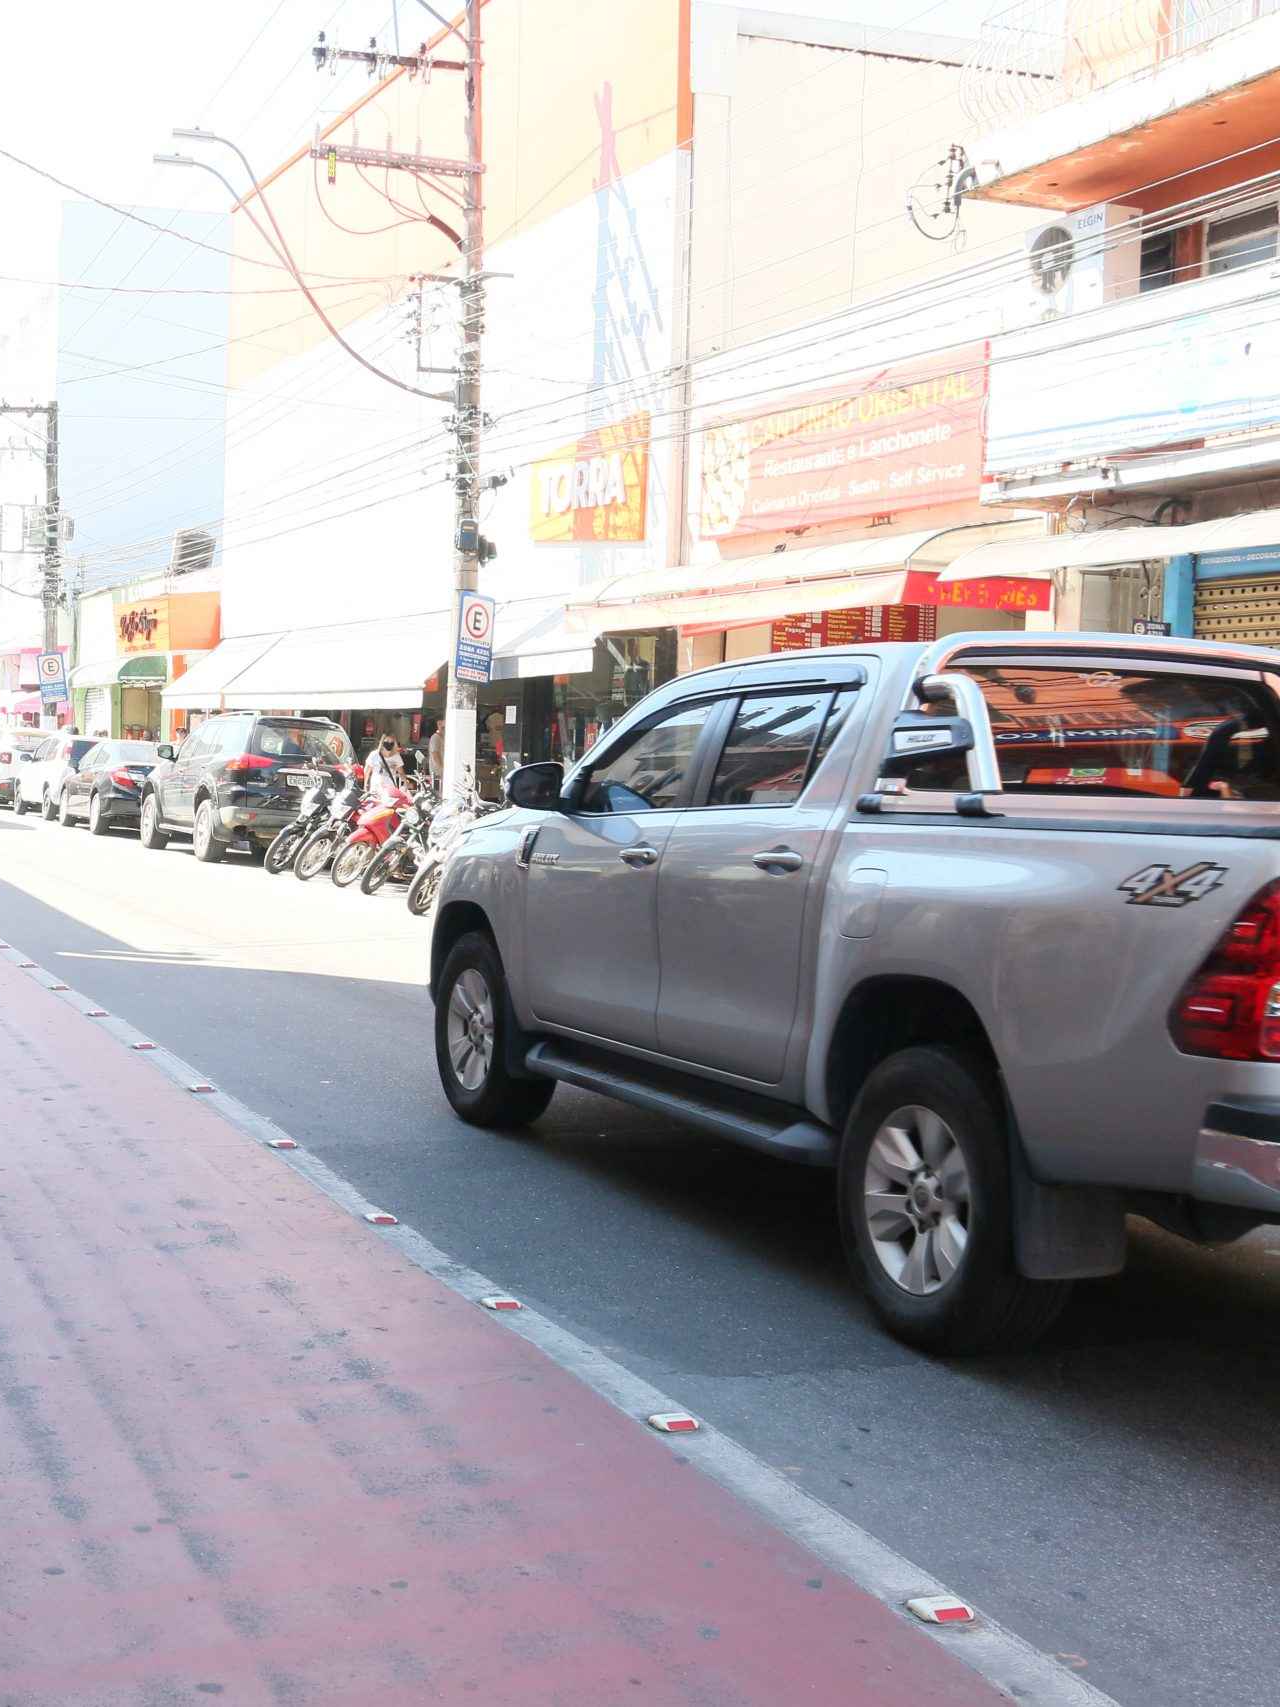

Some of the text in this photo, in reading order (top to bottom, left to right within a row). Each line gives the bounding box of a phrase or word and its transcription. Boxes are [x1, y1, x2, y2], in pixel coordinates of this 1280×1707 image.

[1078, 212, 1104, 230] ELGIN
[857, 373, 976, 424] ORIENTAL
[859, 422, 953, 455] Lanchonete
[539, 453, 626, 518] TORRA
[888, 470, 914, 489] Self
[917, 462, 968, 483] Service
[472, 610, 483, 631] E
[47, 661, 56, 672] E
